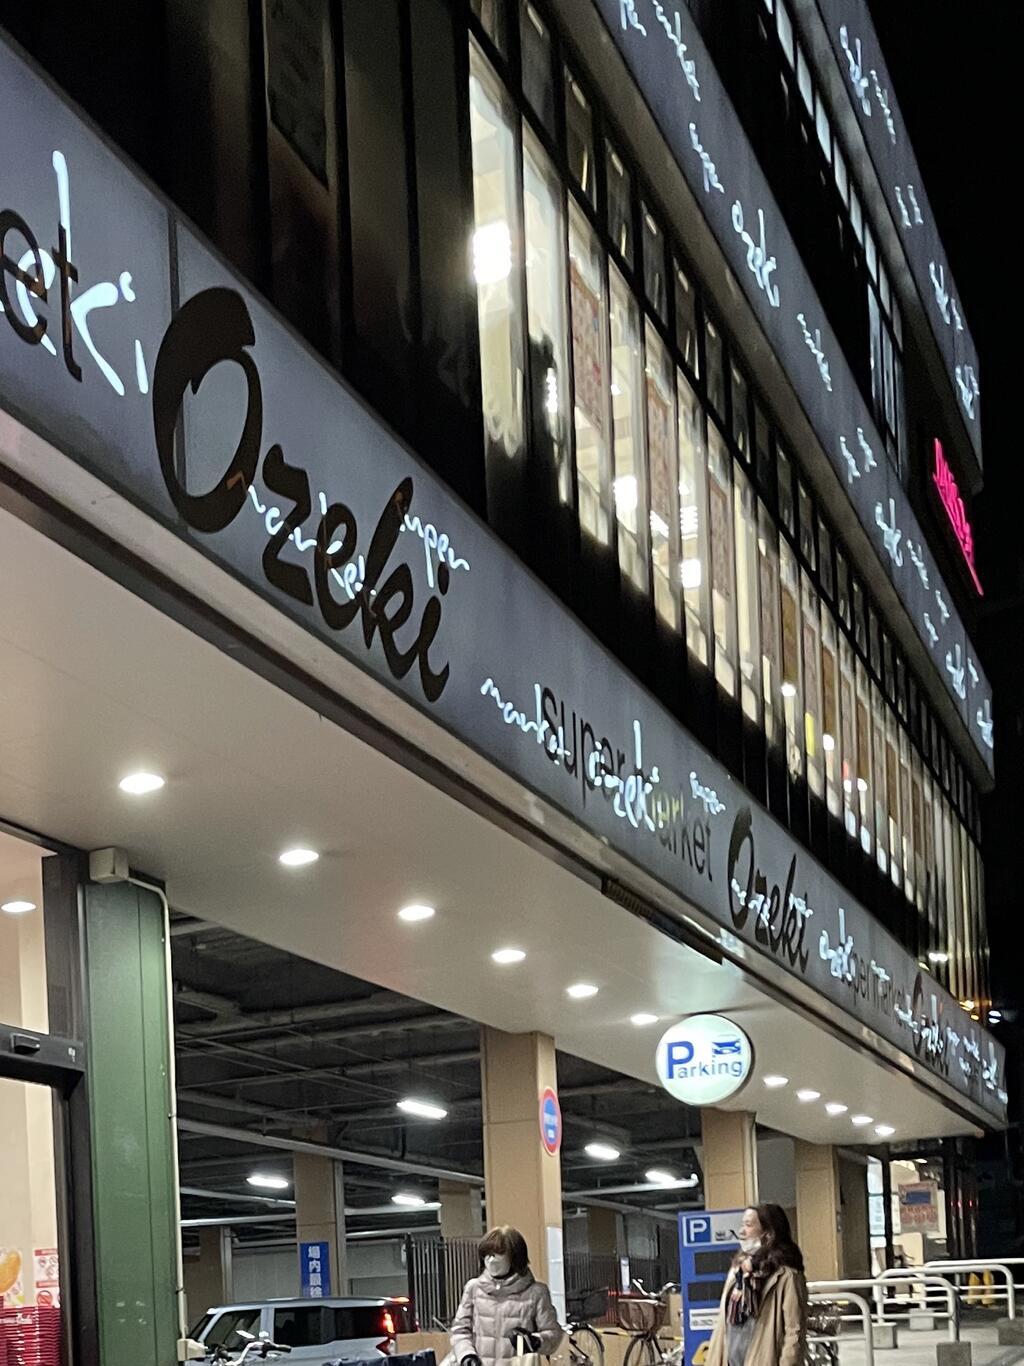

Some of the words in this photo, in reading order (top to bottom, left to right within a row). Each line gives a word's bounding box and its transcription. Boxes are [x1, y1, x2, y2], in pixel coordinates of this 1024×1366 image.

[153, 287, 449, 702] Ozeki
[396, 490, 470, 589] uper
[665, 1040, 743, 1079] Parking
[689, 1219, 708, 1242] P
